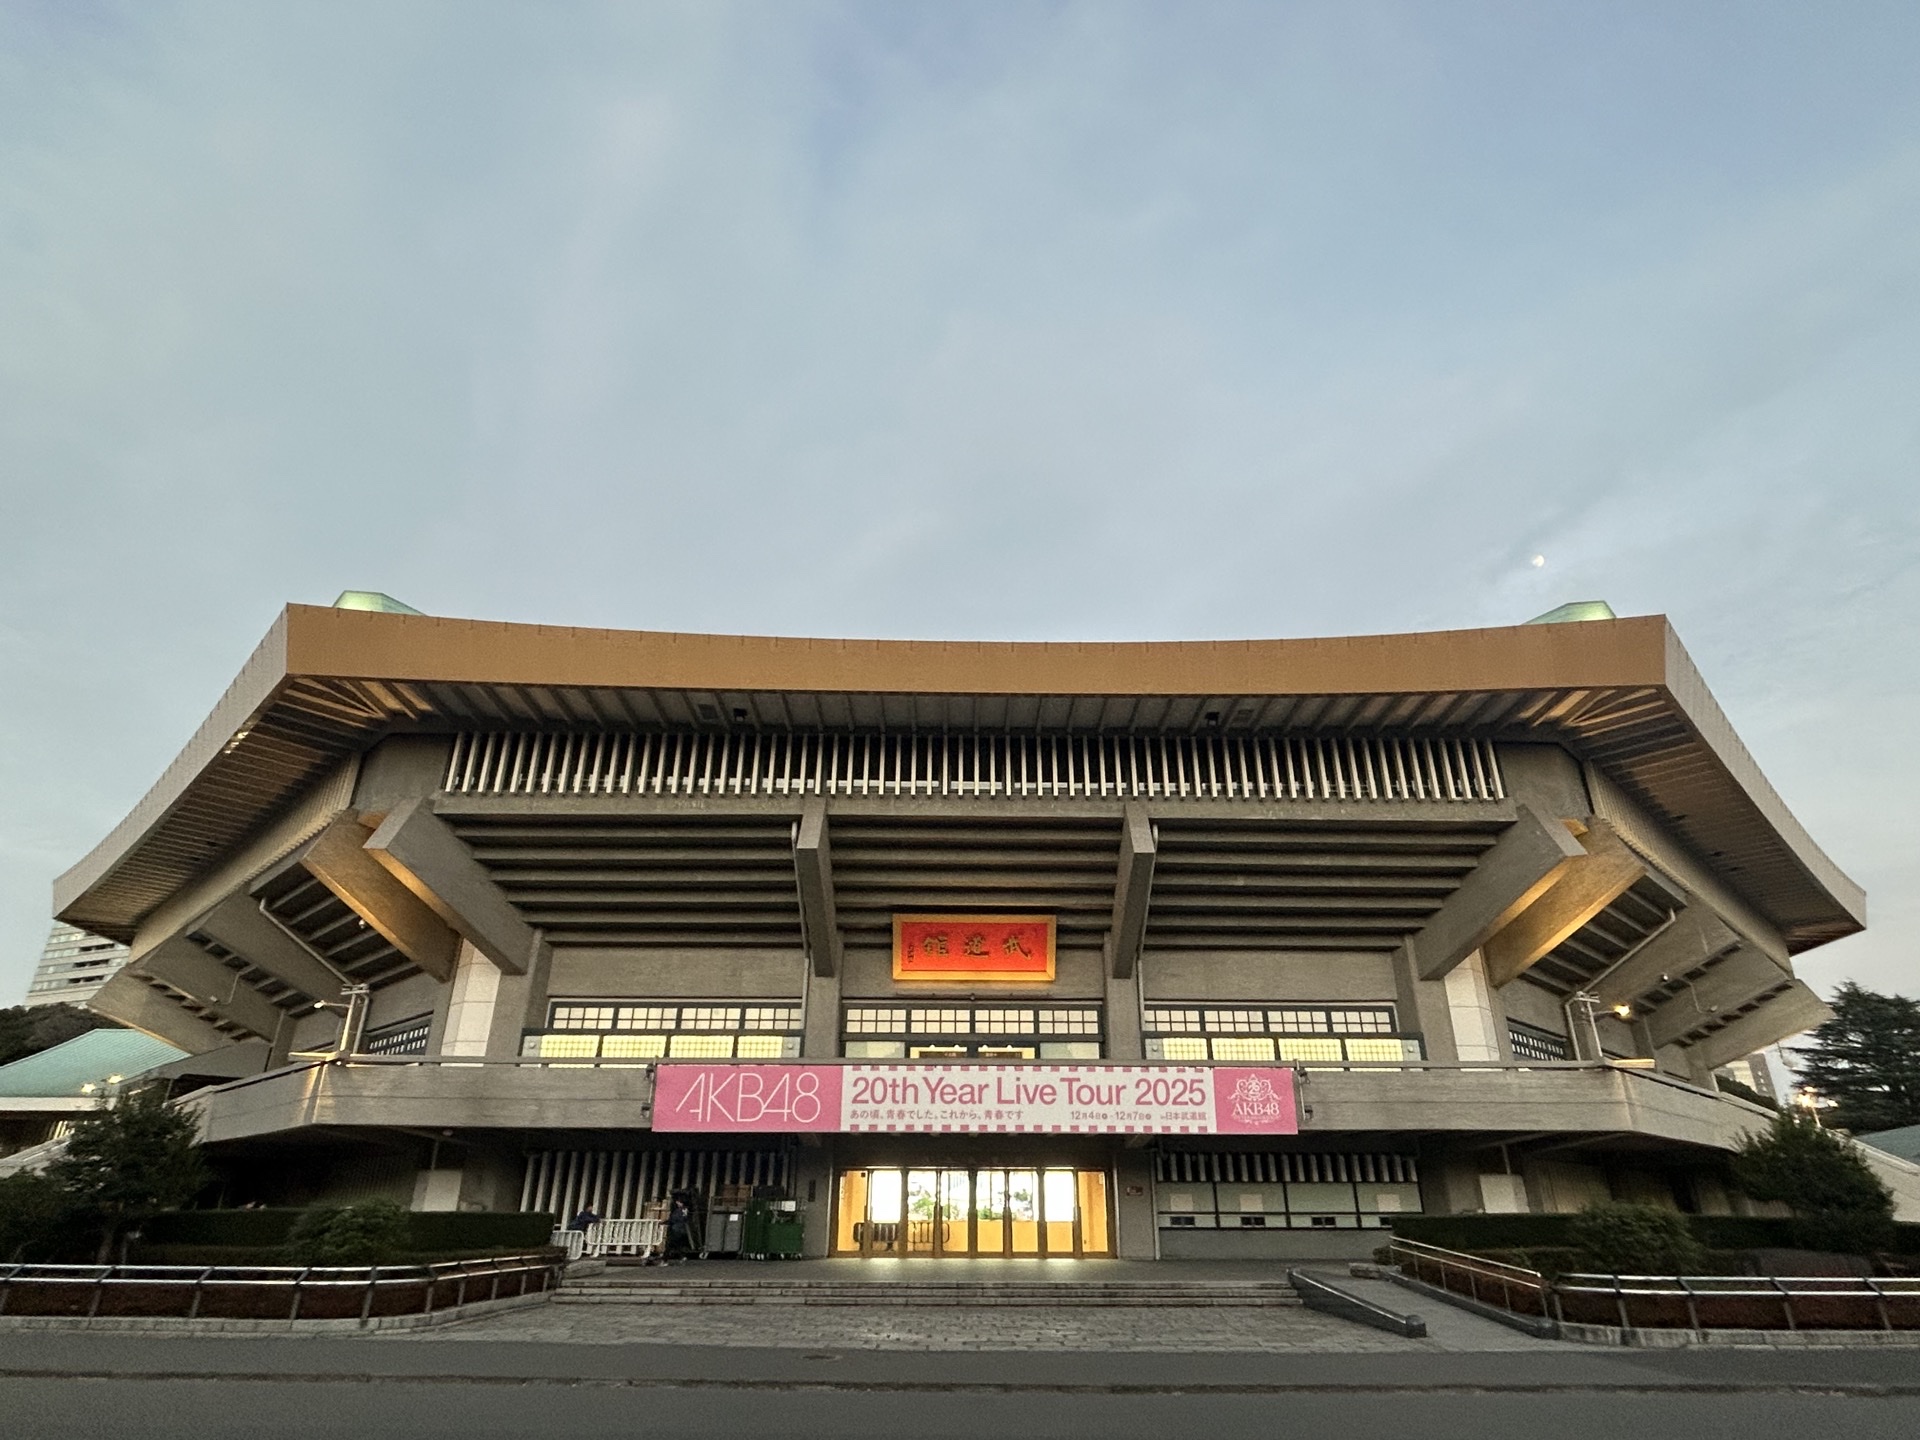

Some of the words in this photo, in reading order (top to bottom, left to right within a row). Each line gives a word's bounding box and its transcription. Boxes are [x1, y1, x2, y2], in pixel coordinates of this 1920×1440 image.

[676, 1073, 820, 1123] AKB48
[851, 1076, 919, 1105] 20th
[923, 1076, 989, 1105] Year
[996, 1077, 1057, 1106] Live
[1060, 1077, 1127, 1107] Tour
[1135, 1078, 1207, 1107] 2025
[1231, 1102, 1280, 1116] AKB48
